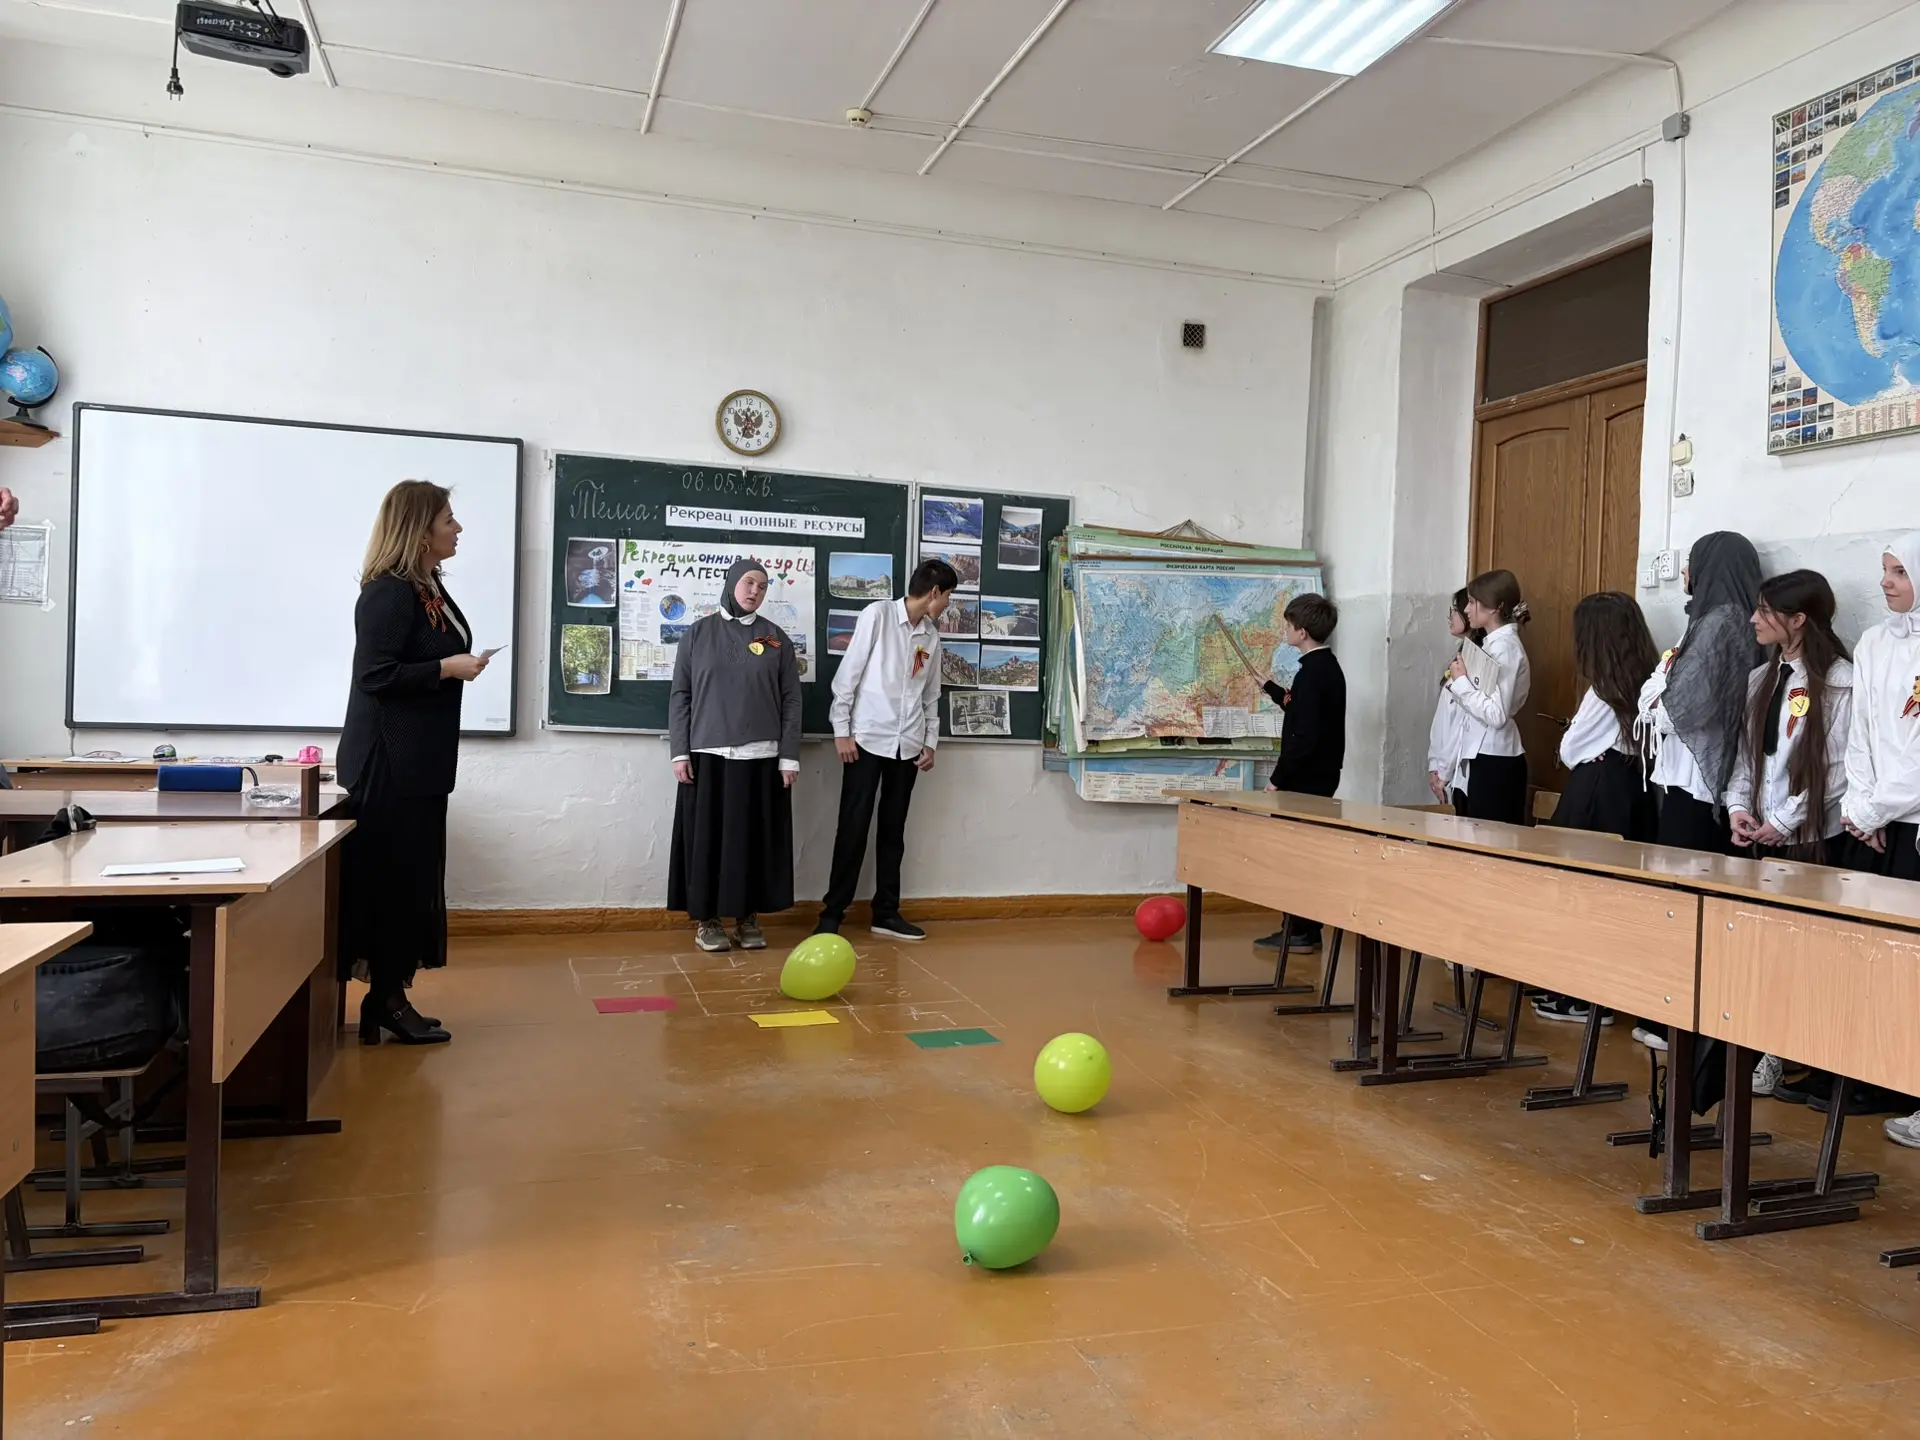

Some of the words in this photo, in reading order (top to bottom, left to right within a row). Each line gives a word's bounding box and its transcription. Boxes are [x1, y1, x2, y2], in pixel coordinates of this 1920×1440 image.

[735, 399, 742, 407] 11
[746, 397, 754, 406] 12
[727, 407, 735, 415] 10
[764, 410, 770, 418] 2
[569, 479, 660, 521] Тема:
[669, 506, 733, 524] Рекреац
[740, 517, 797, 529] ИОННЫЕ
[803, 519, 863, 533] РЕСУРСЫ
[1160, 543, 1192, 551] РОССИЙСКАЯ
[1194, 546, 1224, 554] ФЕДЕРАЦИЯ
[660, 562, 730, 580] ДАГЕСТ
